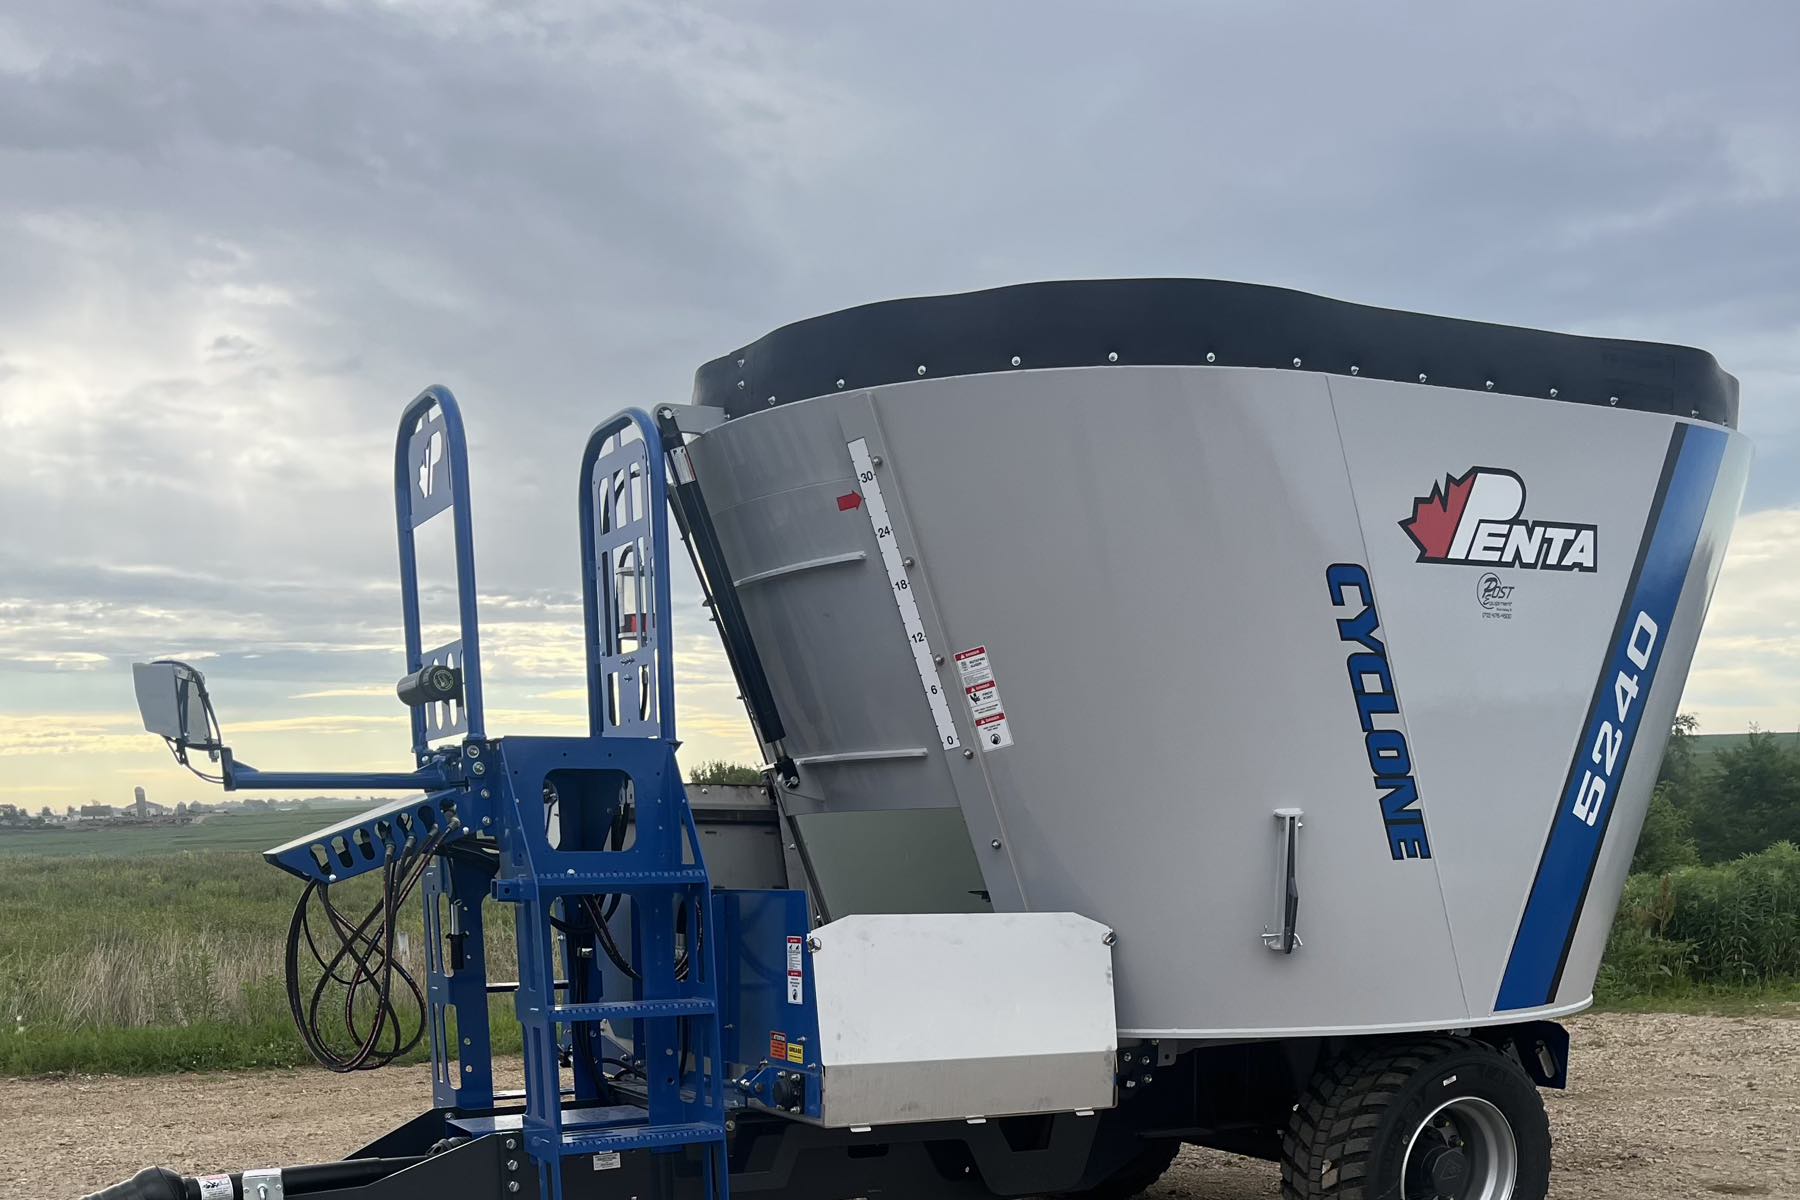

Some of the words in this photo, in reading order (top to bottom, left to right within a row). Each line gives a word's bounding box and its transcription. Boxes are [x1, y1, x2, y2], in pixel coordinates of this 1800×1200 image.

[860, 470, 874, 483] 30
[1445, 467, 1597, 571] PENTA
[877, 525, 891, 538] 24
[895, 579, 908, 591] 18
[911, 632, 925, 644] 12
[930, 684, 938, 695] 6
[1326, 563, 1432, 860] CYCLONE
[1572, 610, 1658, 827] 5240
[946, 735, 954, 745] 0
